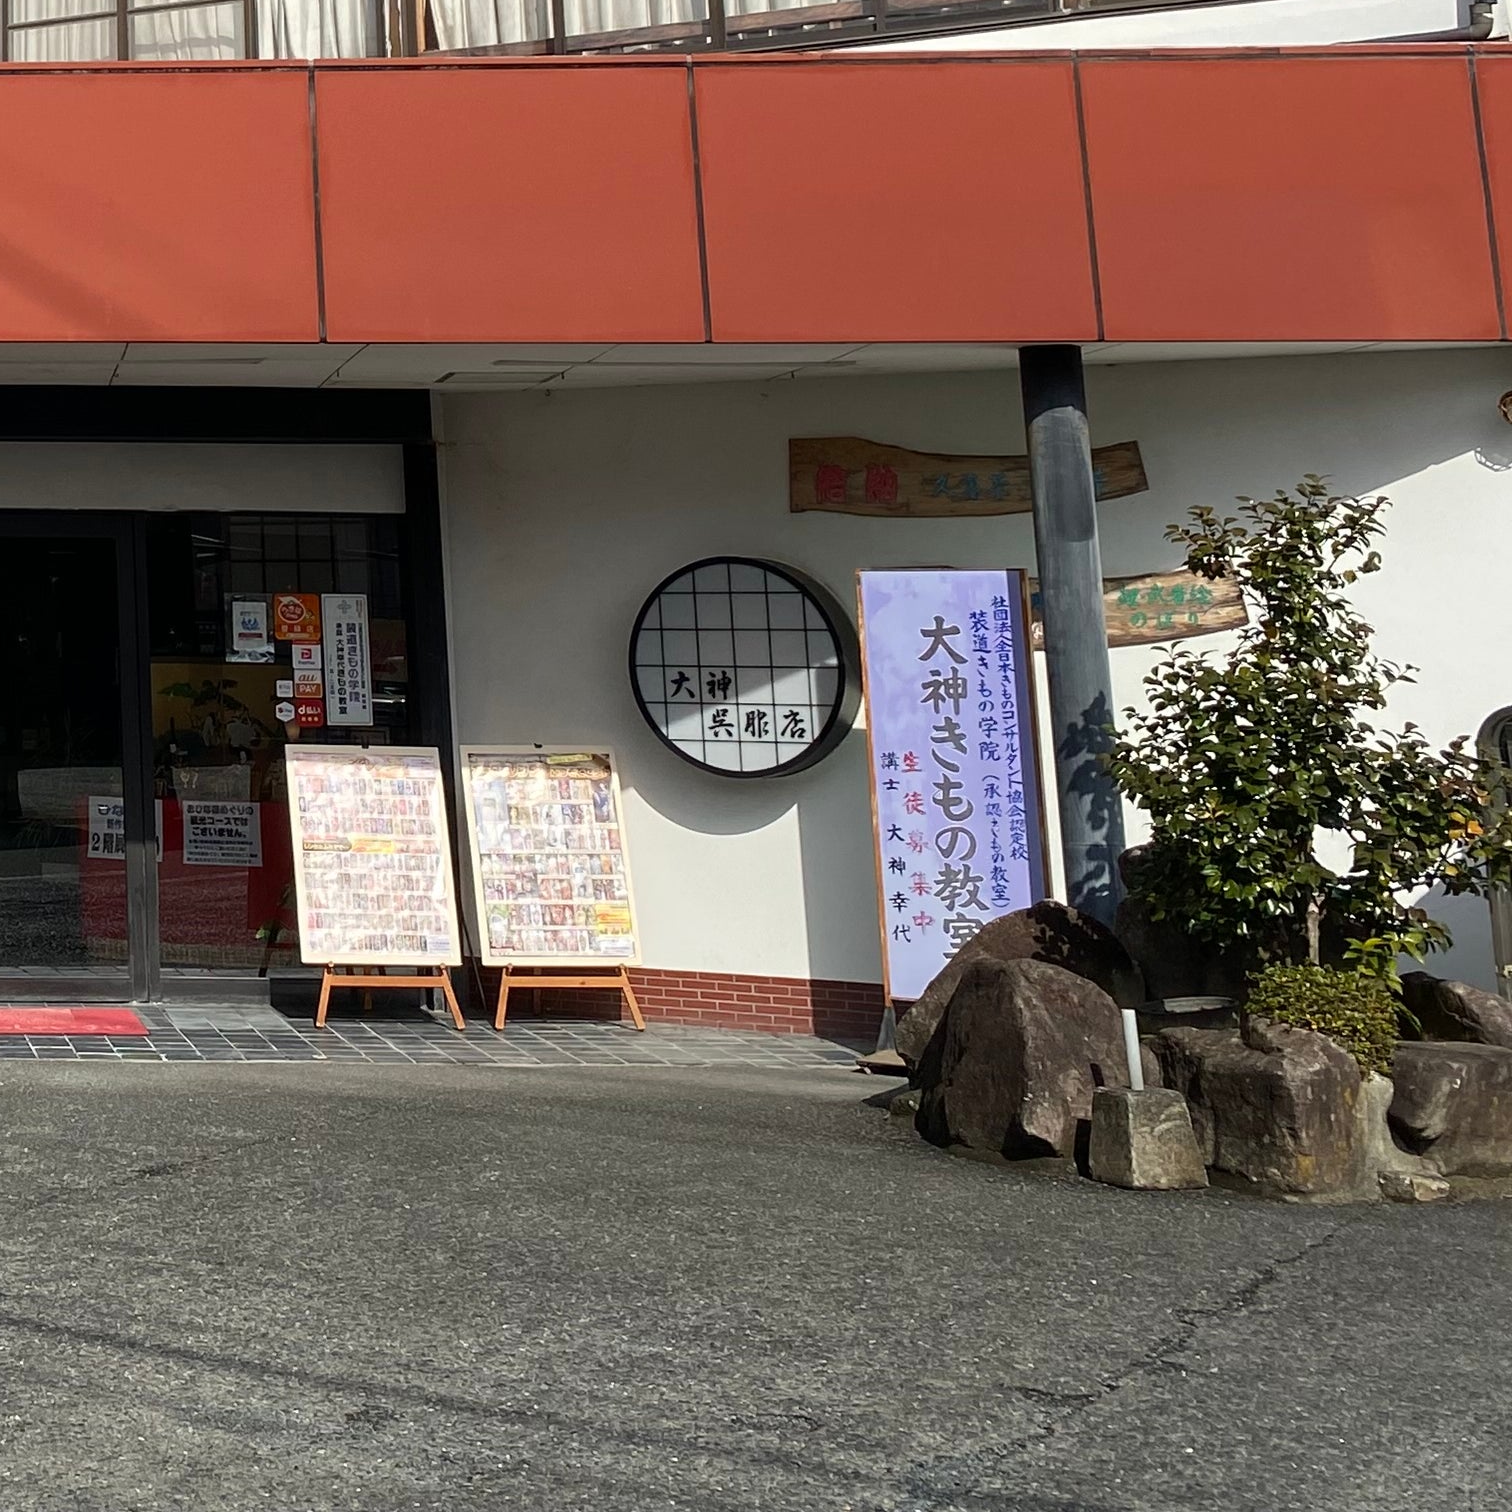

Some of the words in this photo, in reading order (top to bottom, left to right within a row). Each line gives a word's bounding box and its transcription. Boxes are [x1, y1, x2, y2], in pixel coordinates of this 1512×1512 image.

[299, 684, 317, 693] PAY
[670, 671, 732, 702] 大神
[708, 709, 807, 739] 呉服店
[918, 615, 991, 959] 大神きもの教室
[901, 751, 935, 934] 生徒募集中
